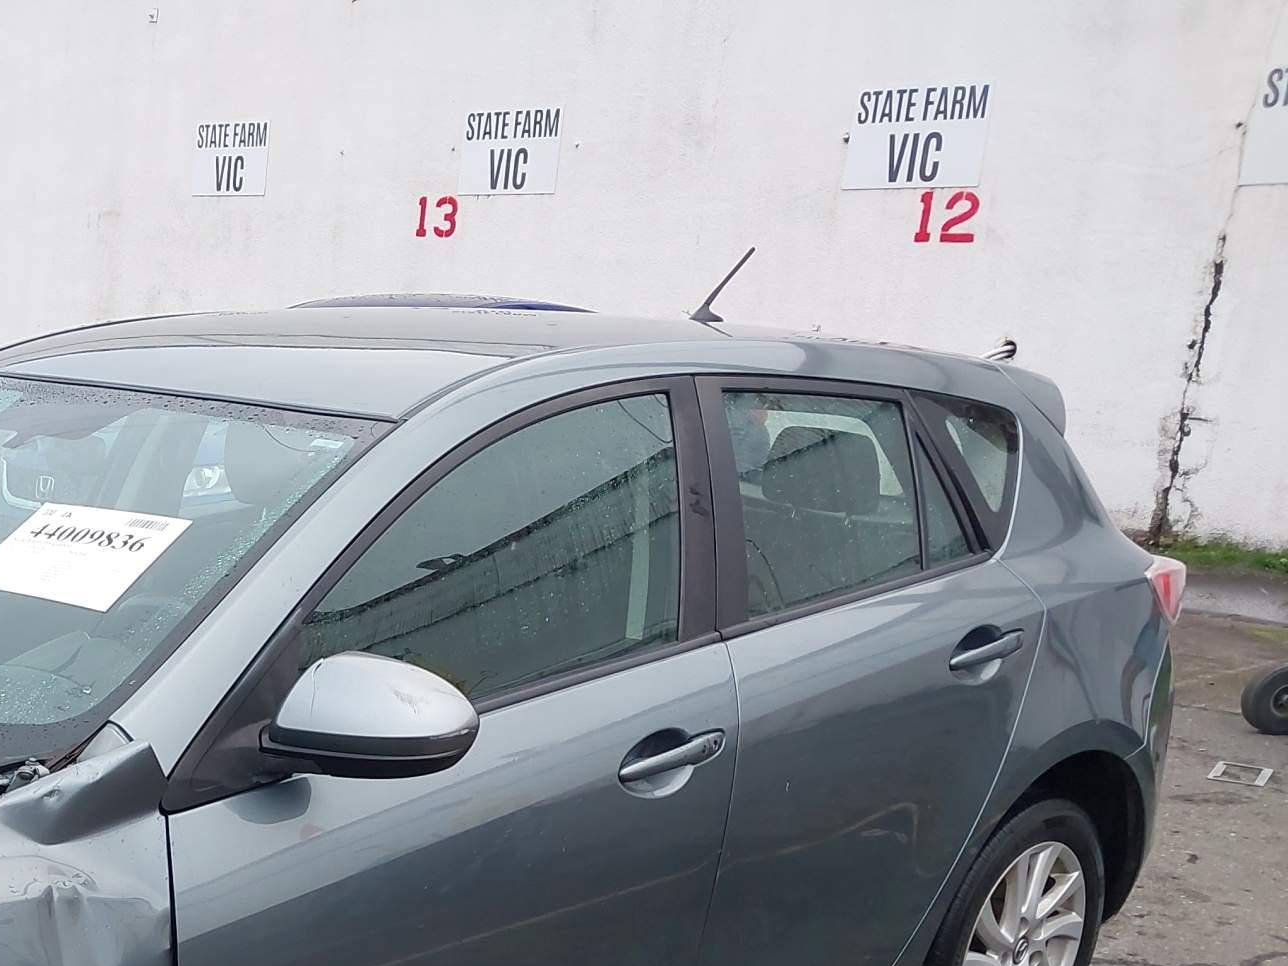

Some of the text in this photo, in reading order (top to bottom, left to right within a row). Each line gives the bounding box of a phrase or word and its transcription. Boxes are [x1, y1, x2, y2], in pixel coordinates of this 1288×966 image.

[466, 108, 560, 140] STATE FARM
[857, 84, 990, 125] STATE FARM
[197, 122, 268, 148] STATE FARM
[215, 155, 244, 192] VIC
[489, 148, 528, 190] VIC
[888, 131, 943, 183] VIC
[416, 196, 458, 238] 13
[913, 191, 980, 243] 12
[30, 523, 152, 553] 44009836
